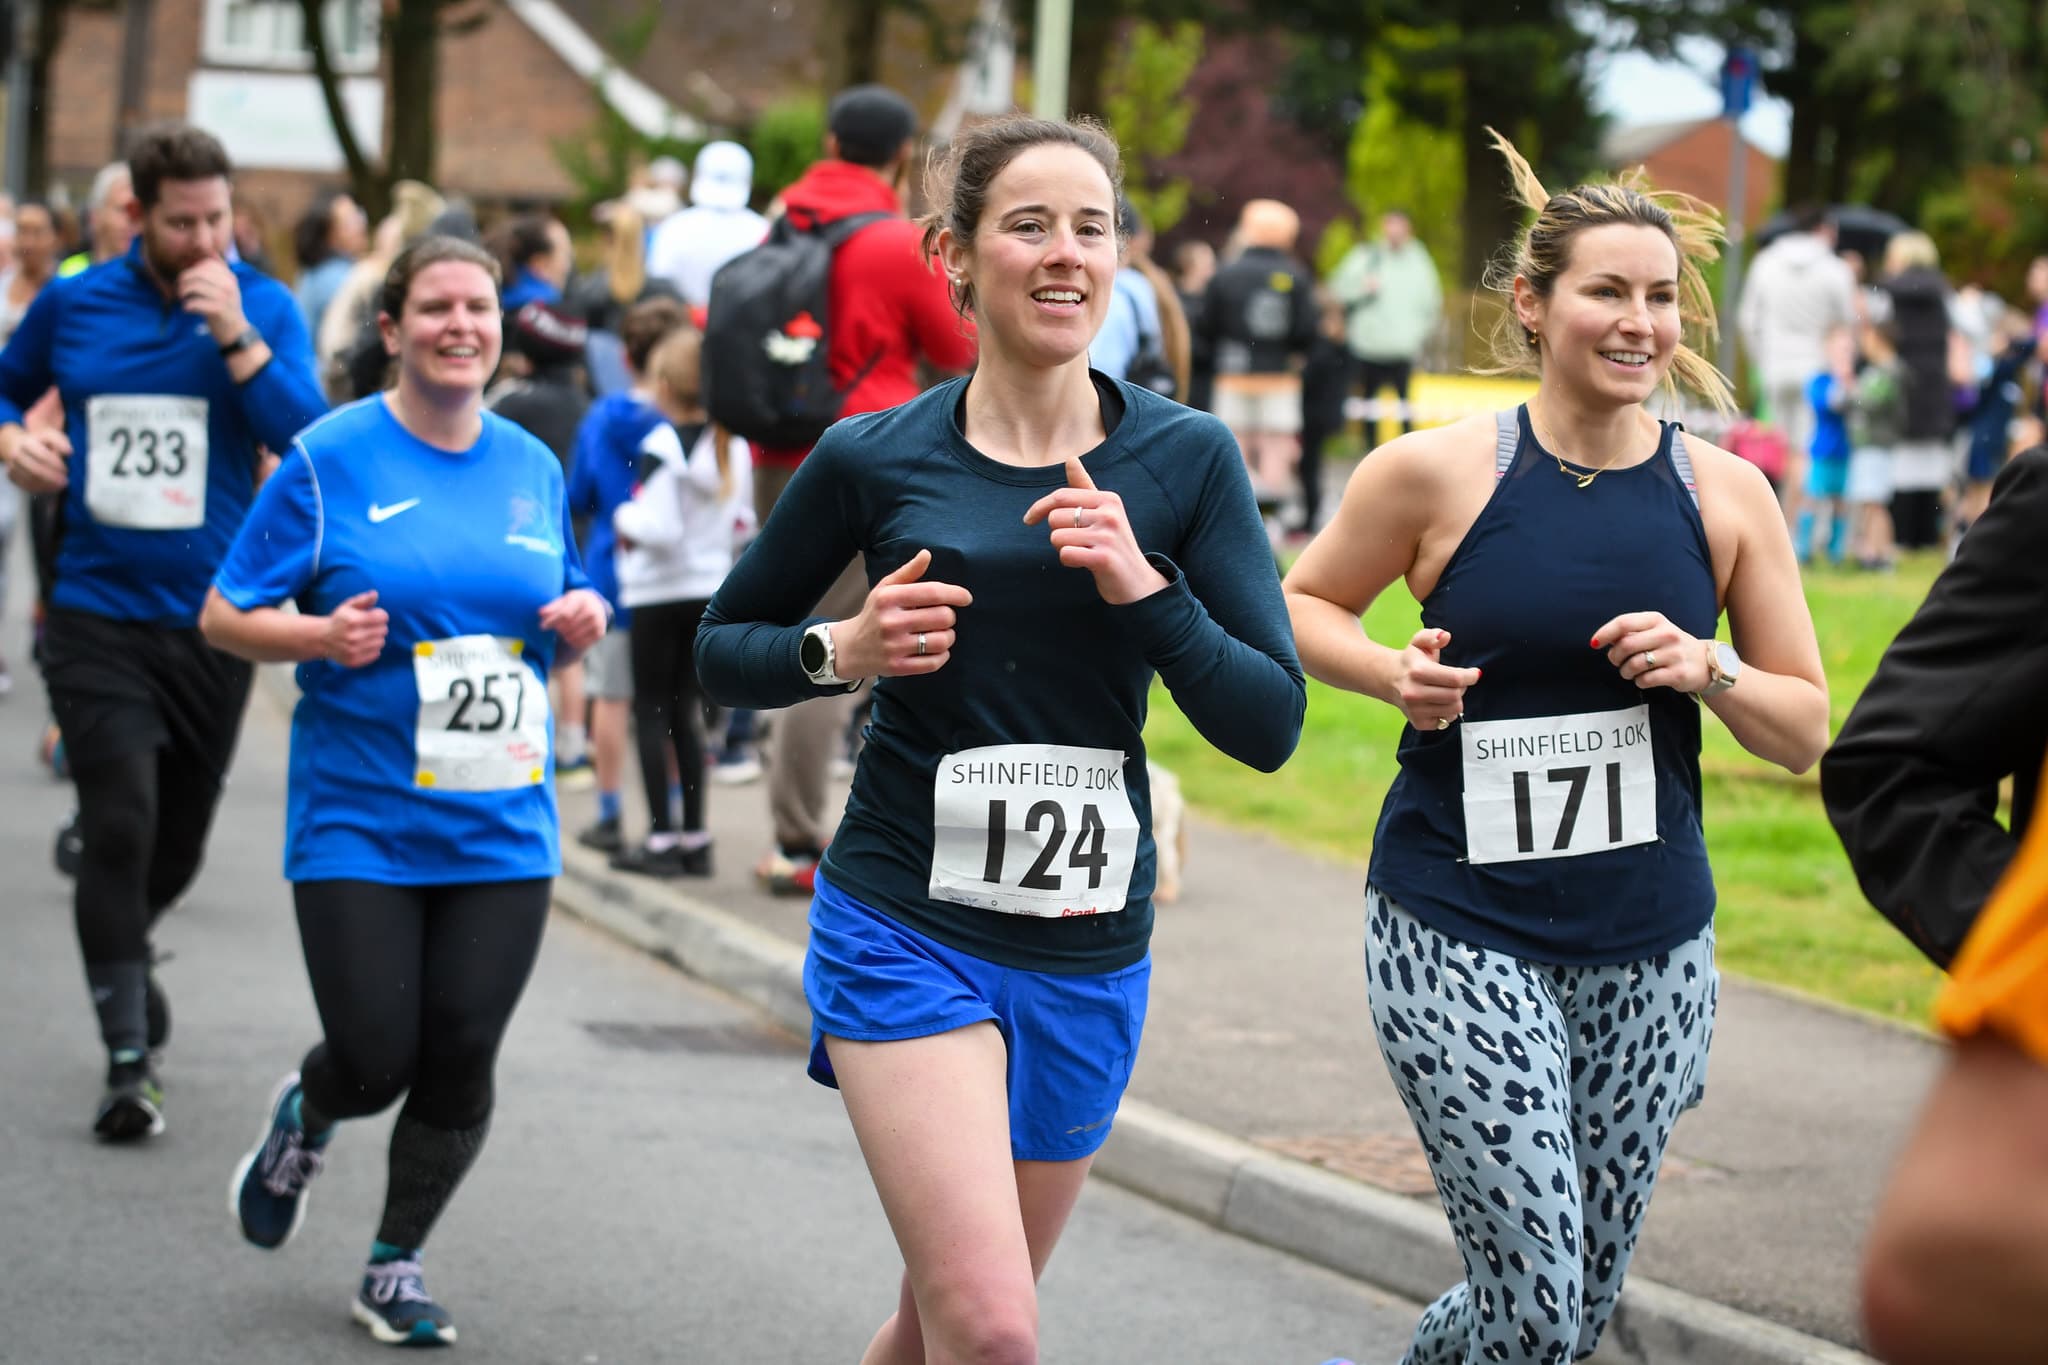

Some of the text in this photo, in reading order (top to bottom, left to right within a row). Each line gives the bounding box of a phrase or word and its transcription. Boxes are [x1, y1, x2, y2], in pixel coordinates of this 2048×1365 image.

[109, 427, 187, 478] 233
[445, 671, 525, 733] 257
[1476, 721, 1648, 760] SHINFIELD 10K
[951, 762, 1120, 791] SHINFIELD 10K
[1512, 761, 1623, 853] 171
[983, 799, 1108, 891] 124
